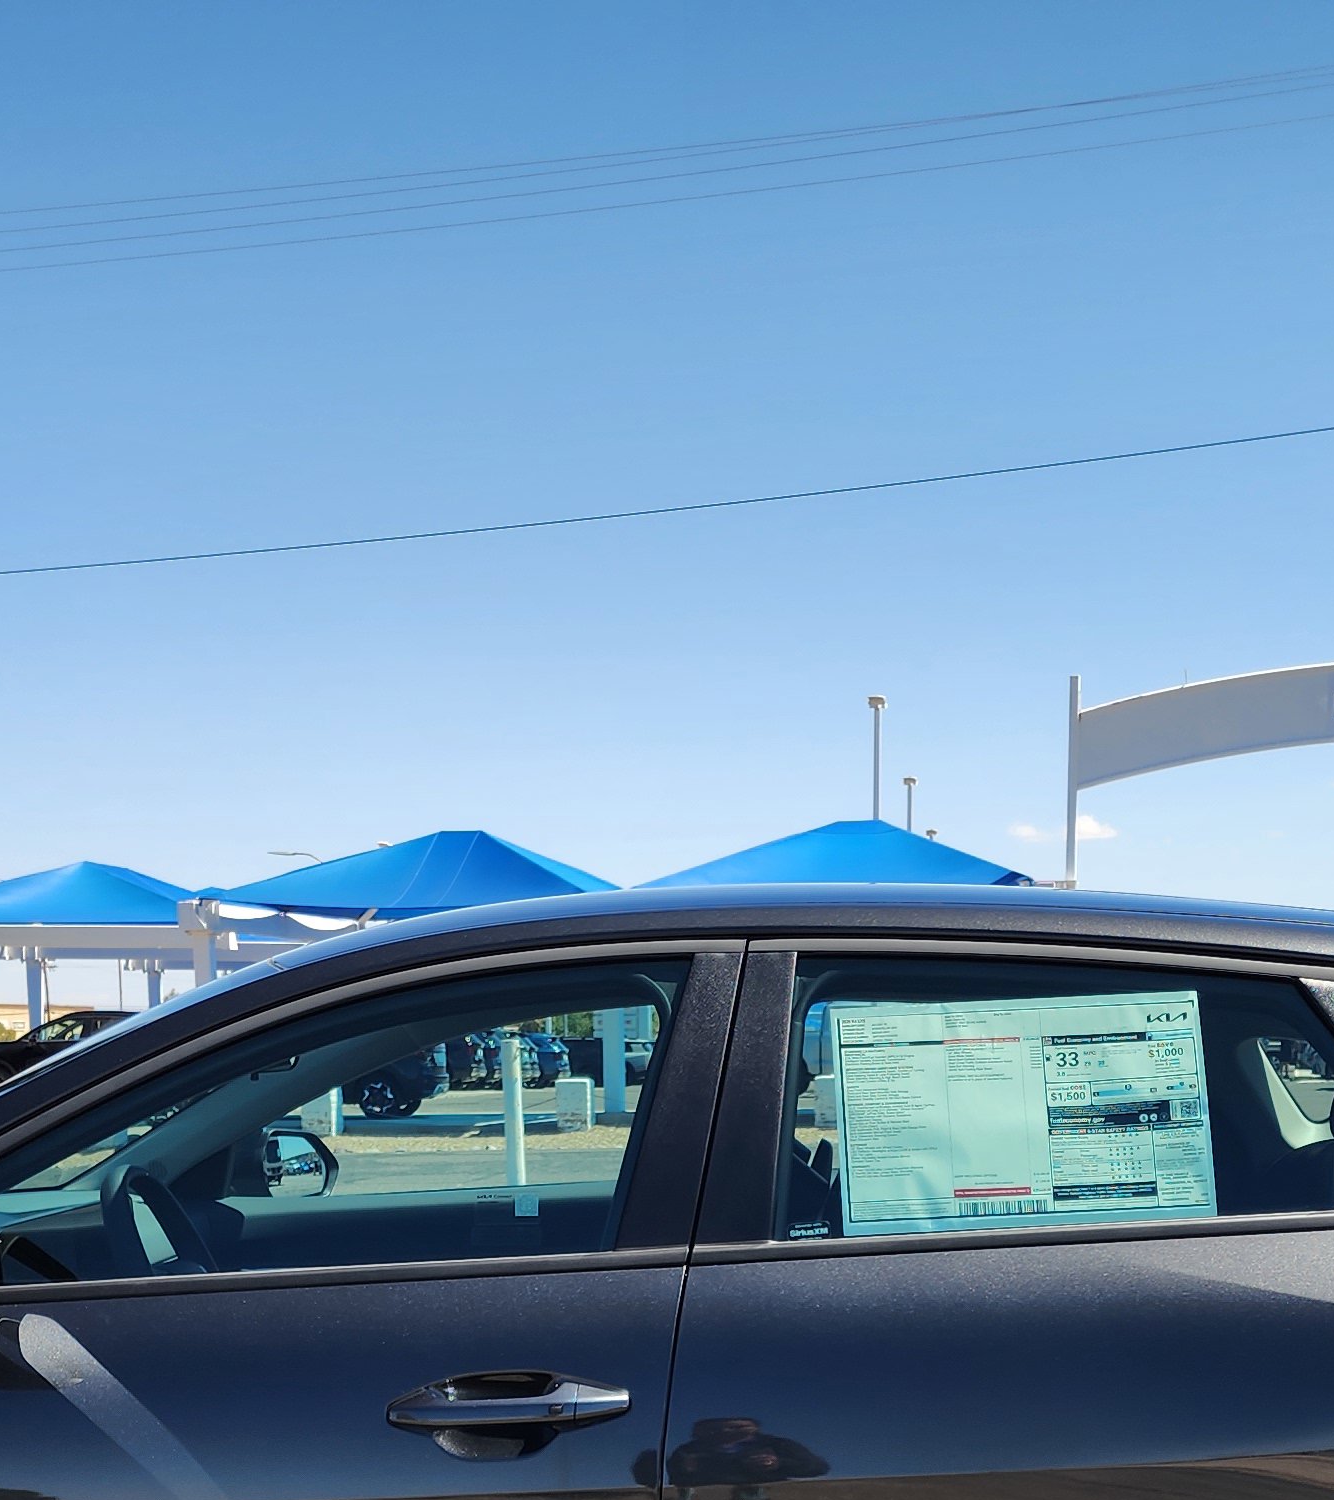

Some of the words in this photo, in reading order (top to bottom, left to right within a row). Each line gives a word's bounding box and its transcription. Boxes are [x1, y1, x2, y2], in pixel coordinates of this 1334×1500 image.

[1146, 1012, 1188, 1023] KIA
[1148, 1047, 1184, 1058] $1,000
[1056, 1052, 1079, 1067] 33
[1050, 1091, 1086, 1102] $1,500
[789, 1227, 829, 1237] SiriusXM
